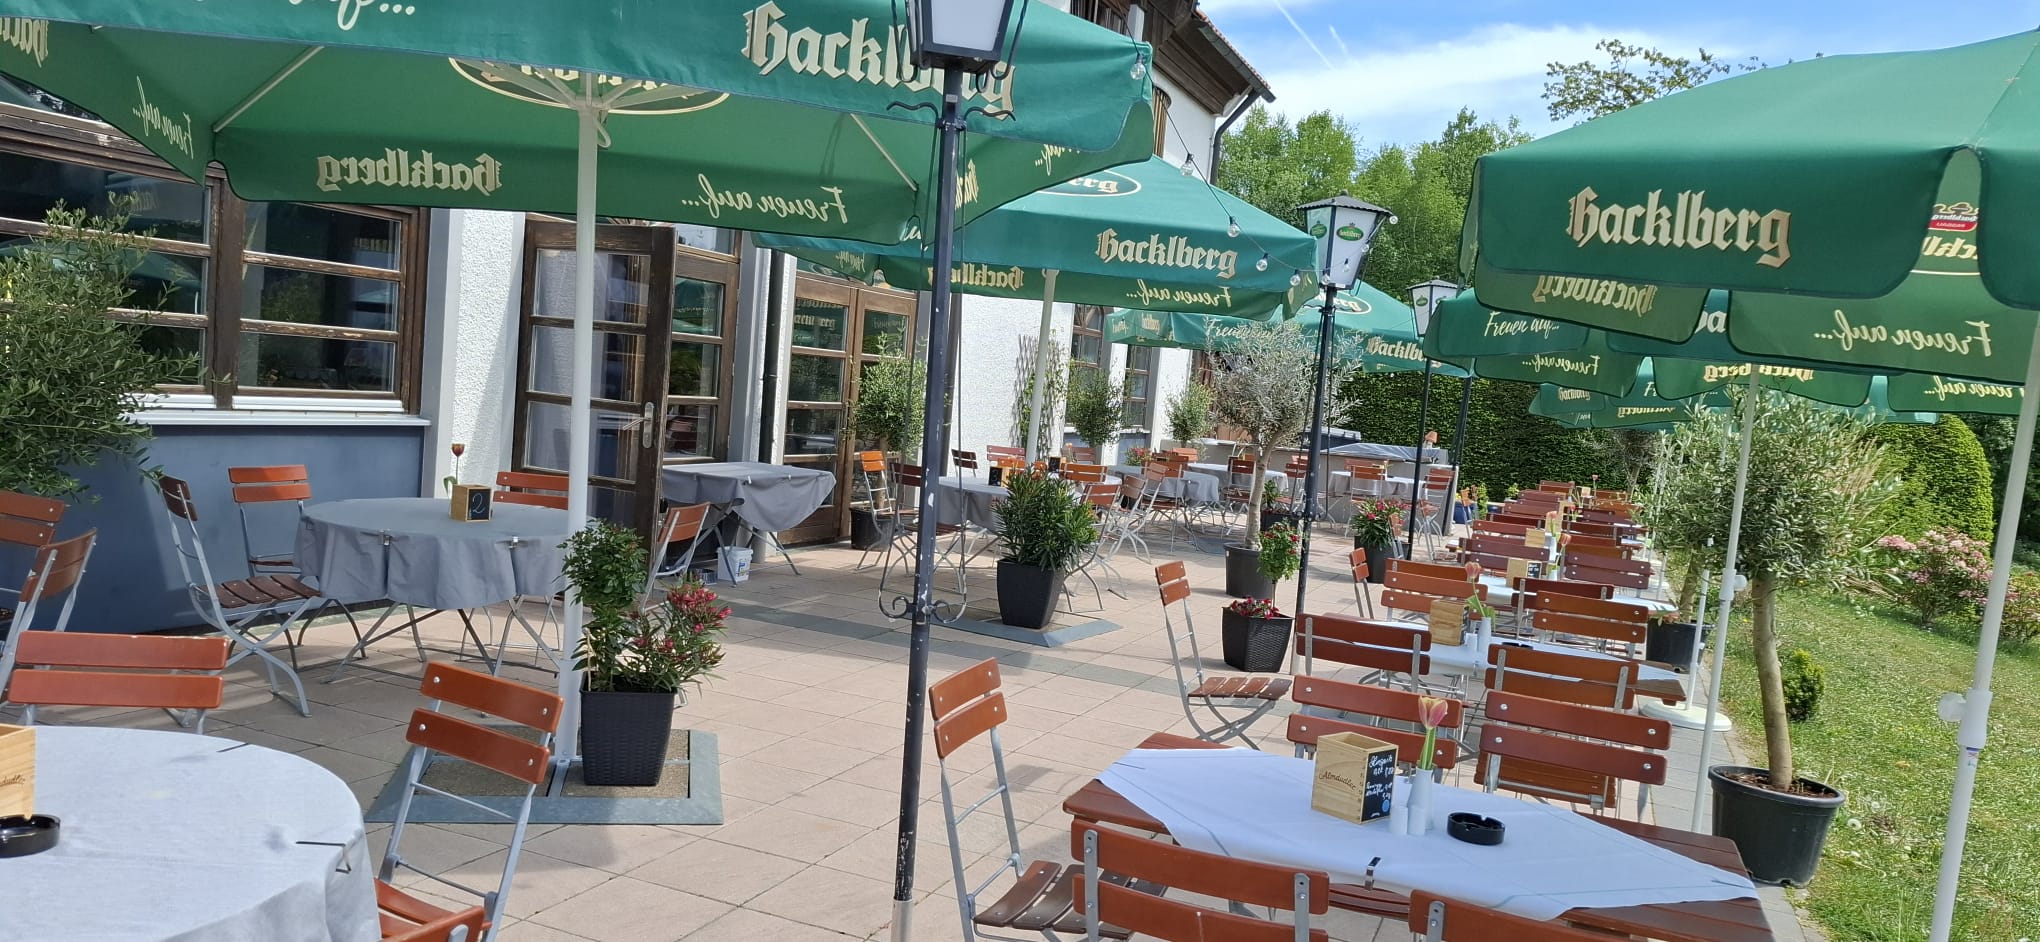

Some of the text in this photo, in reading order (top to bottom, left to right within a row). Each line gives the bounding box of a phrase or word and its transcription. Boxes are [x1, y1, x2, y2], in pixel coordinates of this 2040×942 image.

[741, 1, 1016, 121] Hacklbg
[1566, 186, 1793, 268] Hacklberg
[1095, 228, 1239, 280] Hacklberg
[1484, 310, 1529, 337] Freuen
[472, 492, 486, 514] 2
